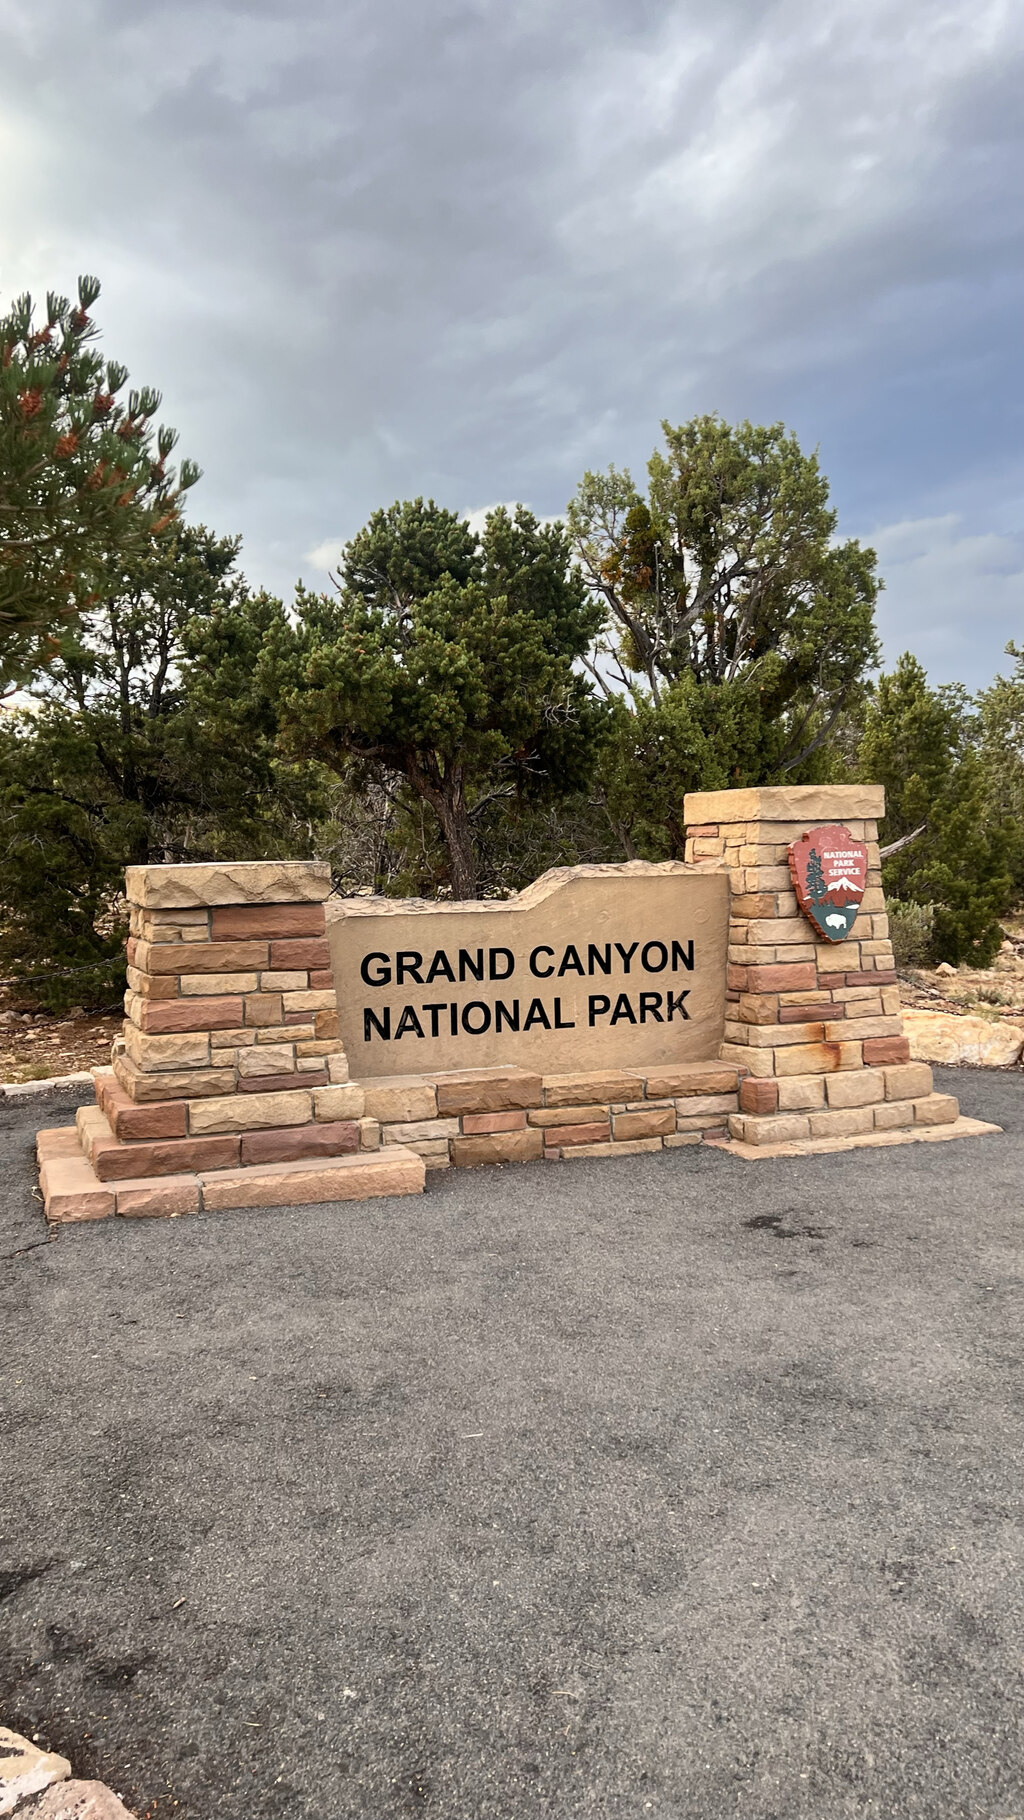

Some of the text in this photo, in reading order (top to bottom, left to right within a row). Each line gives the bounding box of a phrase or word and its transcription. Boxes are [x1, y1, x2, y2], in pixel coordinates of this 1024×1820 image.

[823, 851, 863, 859] NATIONAL
[828, 868, 861, 876] SERVICE
[360, 940, 695, 987] GRAND CANYON
[363, 990, 692, 1042] NATIONAL PARK
